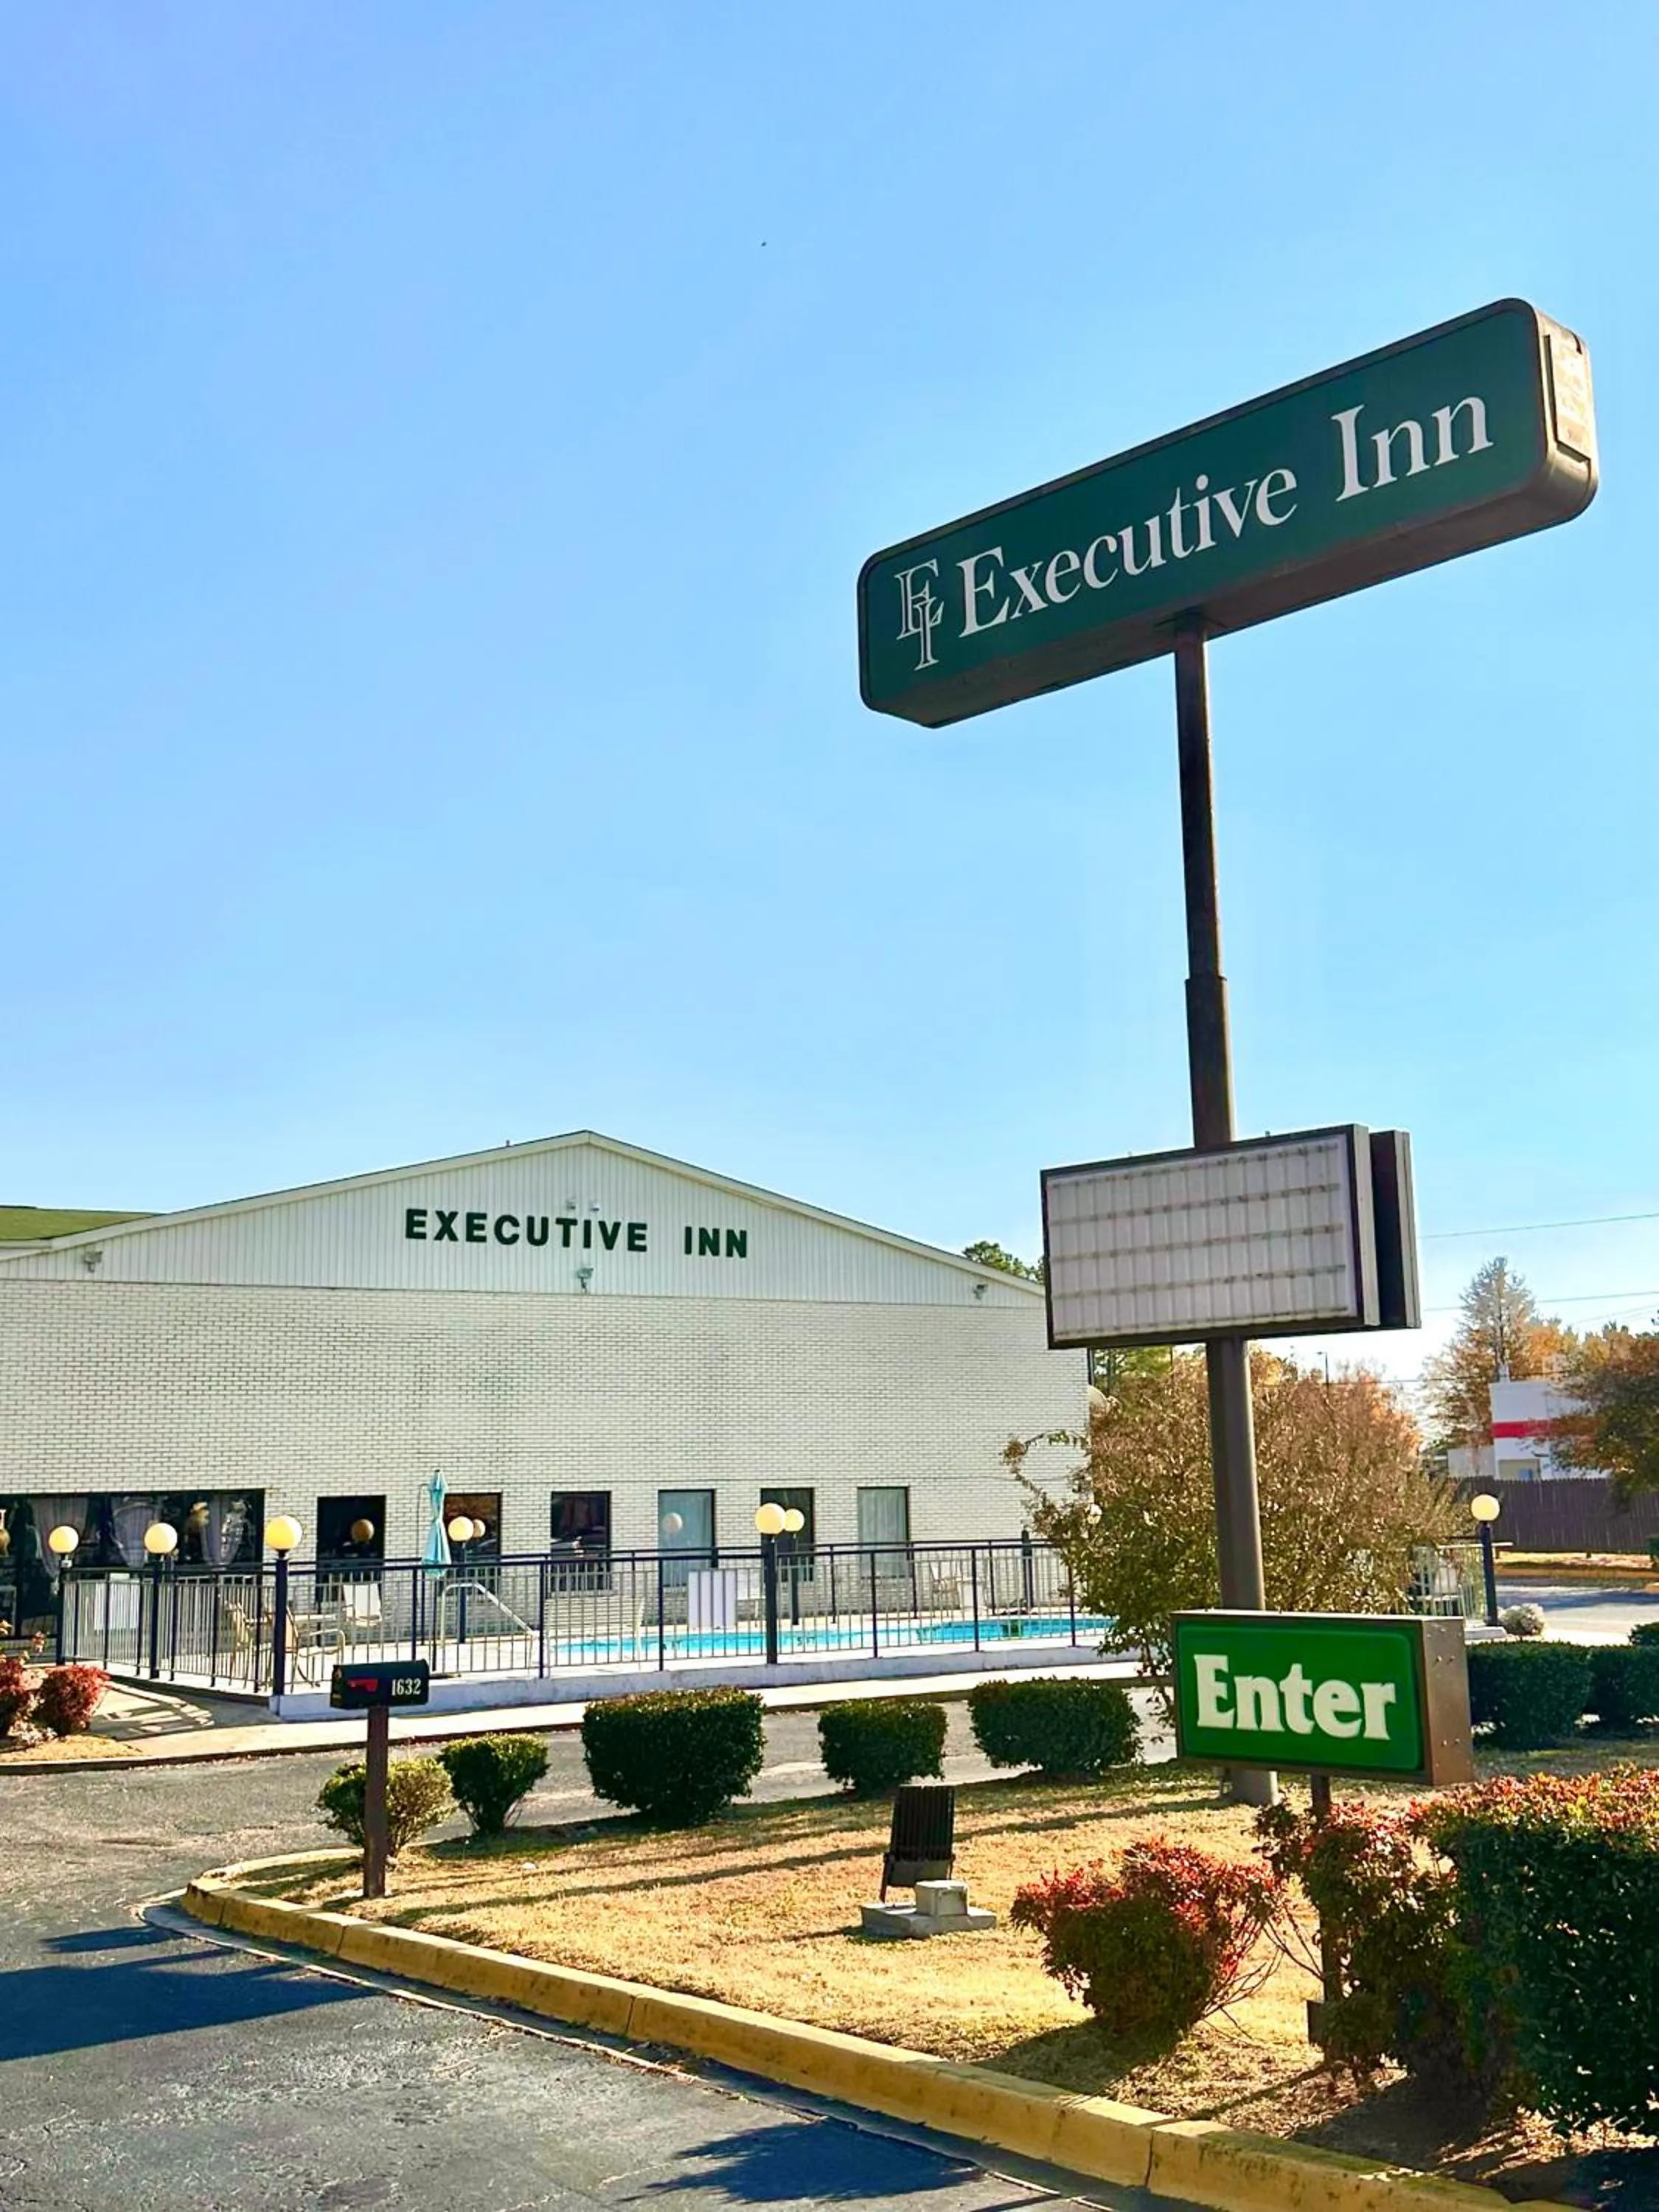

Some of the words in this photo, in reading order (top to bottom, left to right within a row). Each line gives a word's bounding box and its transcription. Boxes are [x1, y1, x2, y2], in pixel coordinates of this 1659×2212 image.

[958, 465, 1298, 638] Executive
[1331, 394, 1494, 501] Inn
[406, 1208, 647, 1252] EXECUTIVE
[684, 1226, 748, 1258] INN
[392, 1678, 421, 1696] 1632
[1193, 1654, 1397, 1741] Enter
